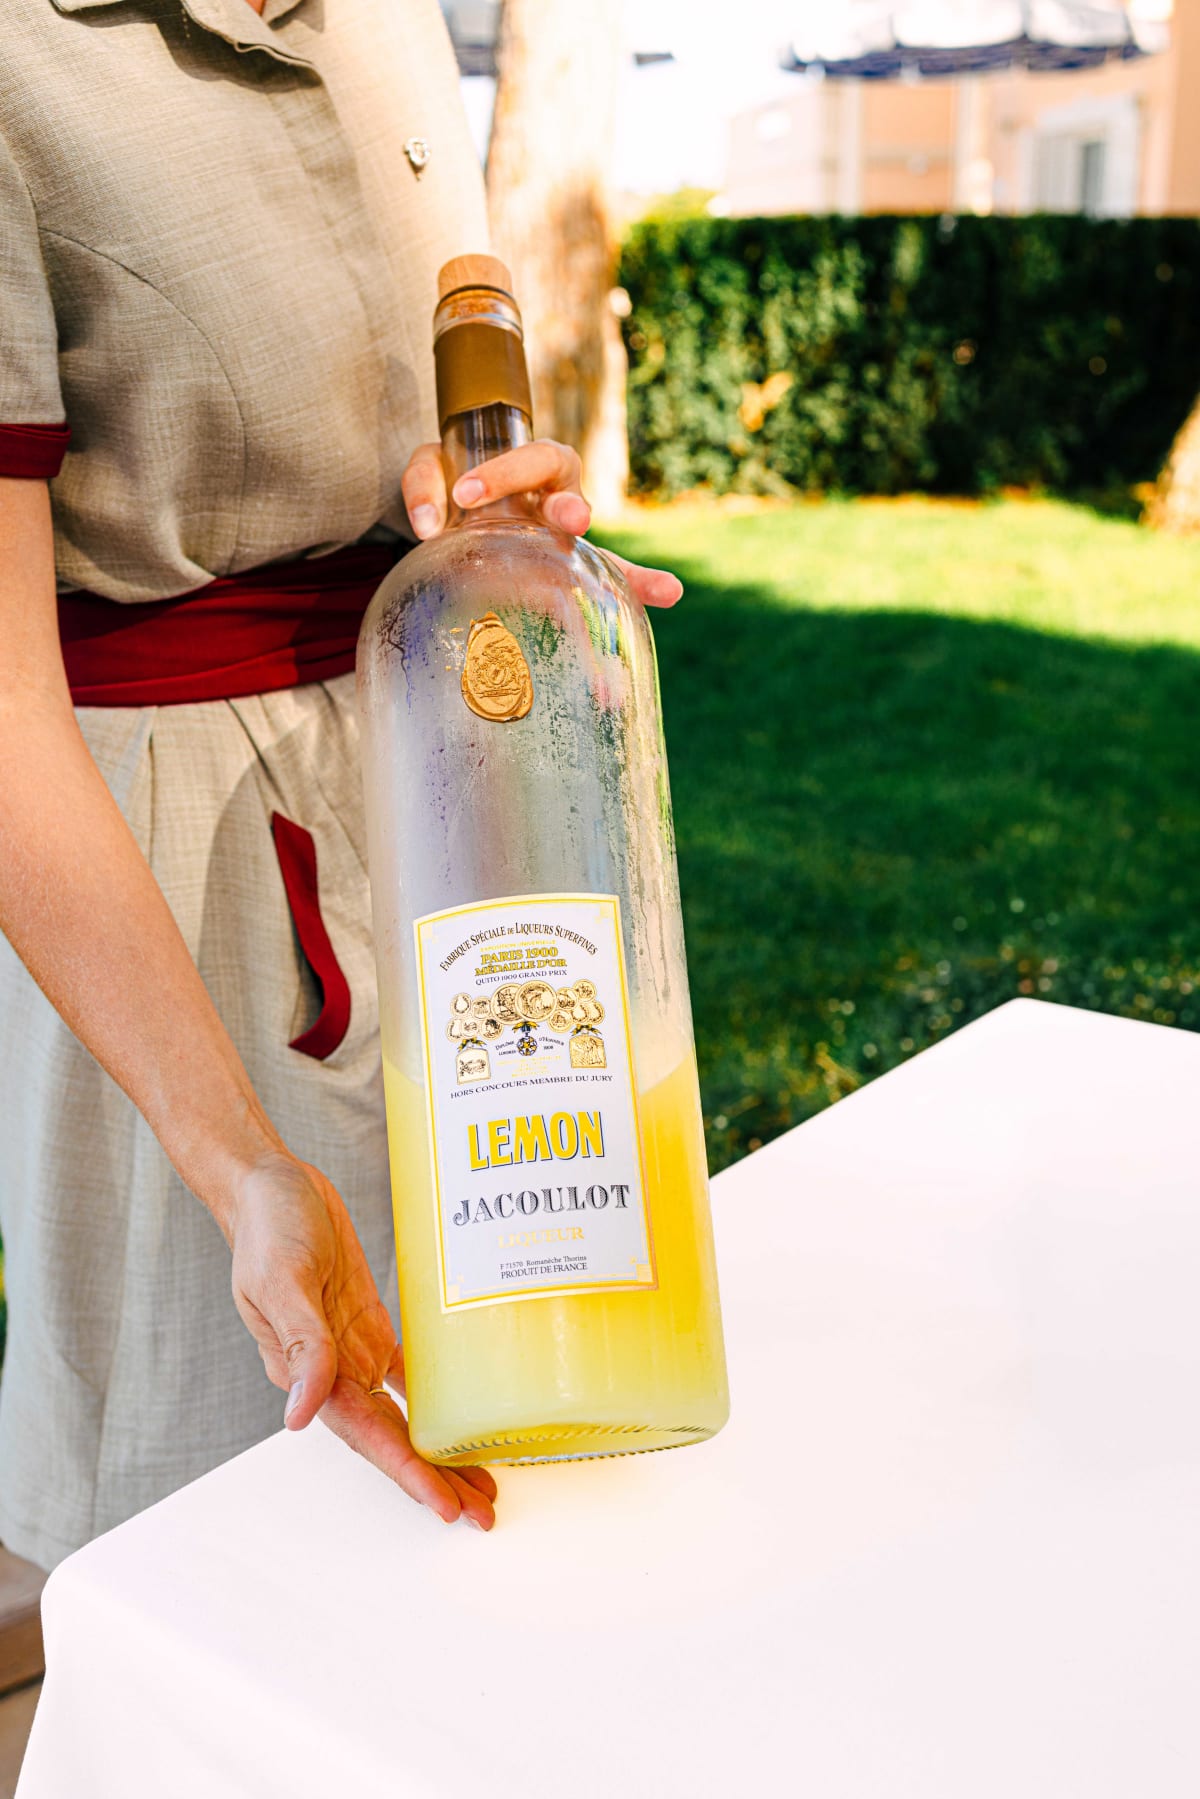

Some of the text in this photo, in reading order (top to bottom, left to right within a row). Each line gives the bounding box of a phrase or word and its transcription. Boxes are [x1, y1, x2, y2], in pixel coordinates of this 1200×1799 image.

[439, 939, 473, 972] FABRIQUE
[470, 926, 507, 946] SPÉCIALE
[515, 922, 554, 935] LIQUEURS
[555, 925, 599, 956] SUPERFINES
[480, 946, 559, 965] PARIS 1900
[474, 961, 536, 976] MÉDAILLE
[475, 976, 499, 985] QUITO
[518, 971, 547, 979] GRAND
[548, 969, 567, 977] PRIX
[450, 1087, 474, 1099] HORS
[475, 1079, 528, 1094] CONCOURS
[529, 1076, 573, 1086] MEMBRE
[590, 1075, 613, 1083] JURY
[467, 1111, 605, 1171] LEMON
[453, 1184, 630, 1226] JACOULOT
[498, 1227, 585, 1249] LIQUEUR
[501, 1262, 588, 1279] PRODUIT DE FRANCE
[526, 1257, 562, 1266] Romanèche
